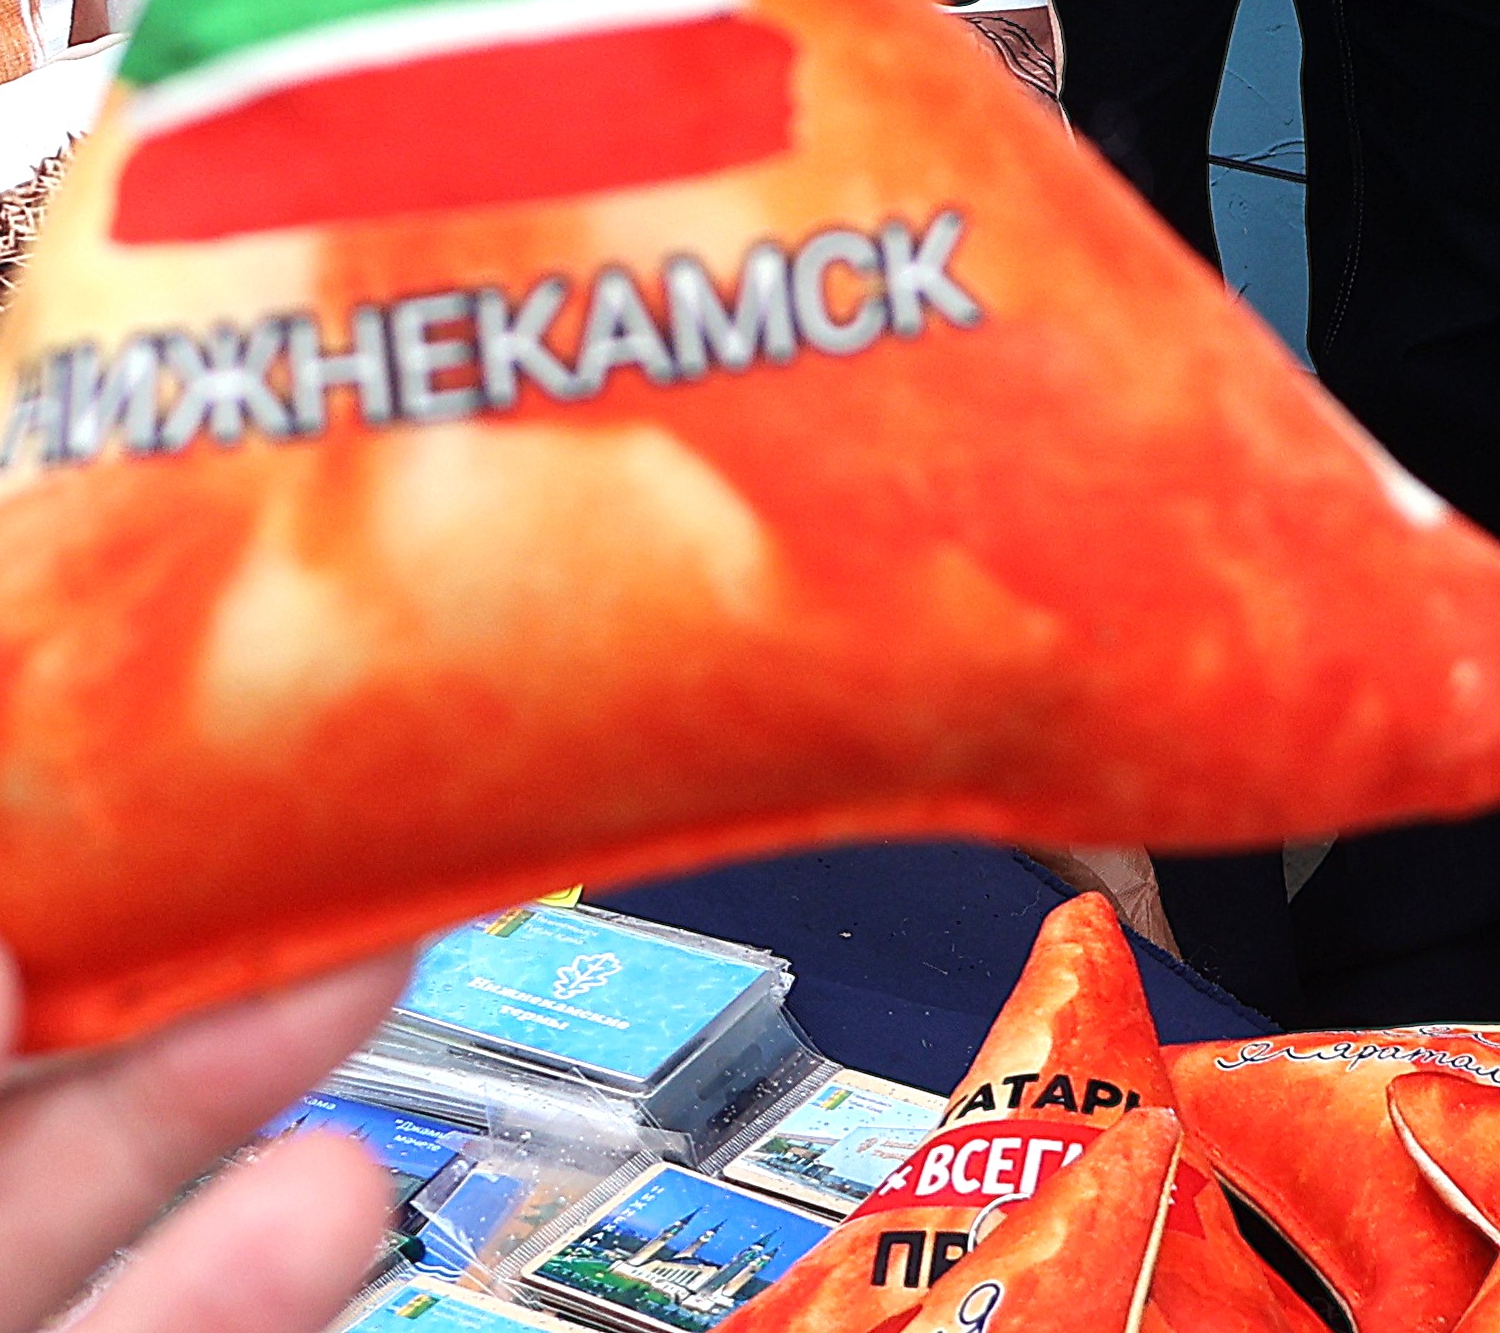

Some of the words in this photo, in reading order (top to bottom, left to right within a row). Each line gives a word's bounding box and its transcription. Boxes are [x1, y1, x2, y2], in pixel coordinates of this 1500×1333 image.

[467, 976, 632, 1031] Нижнекамские
[498, 1004, 571, 1031] термы
[937, 1073, 1143, 1129] АТАР
[916, 1137, 1085, 1198] ВСЕГ
[871, 1230, 970, 1289] ПР
